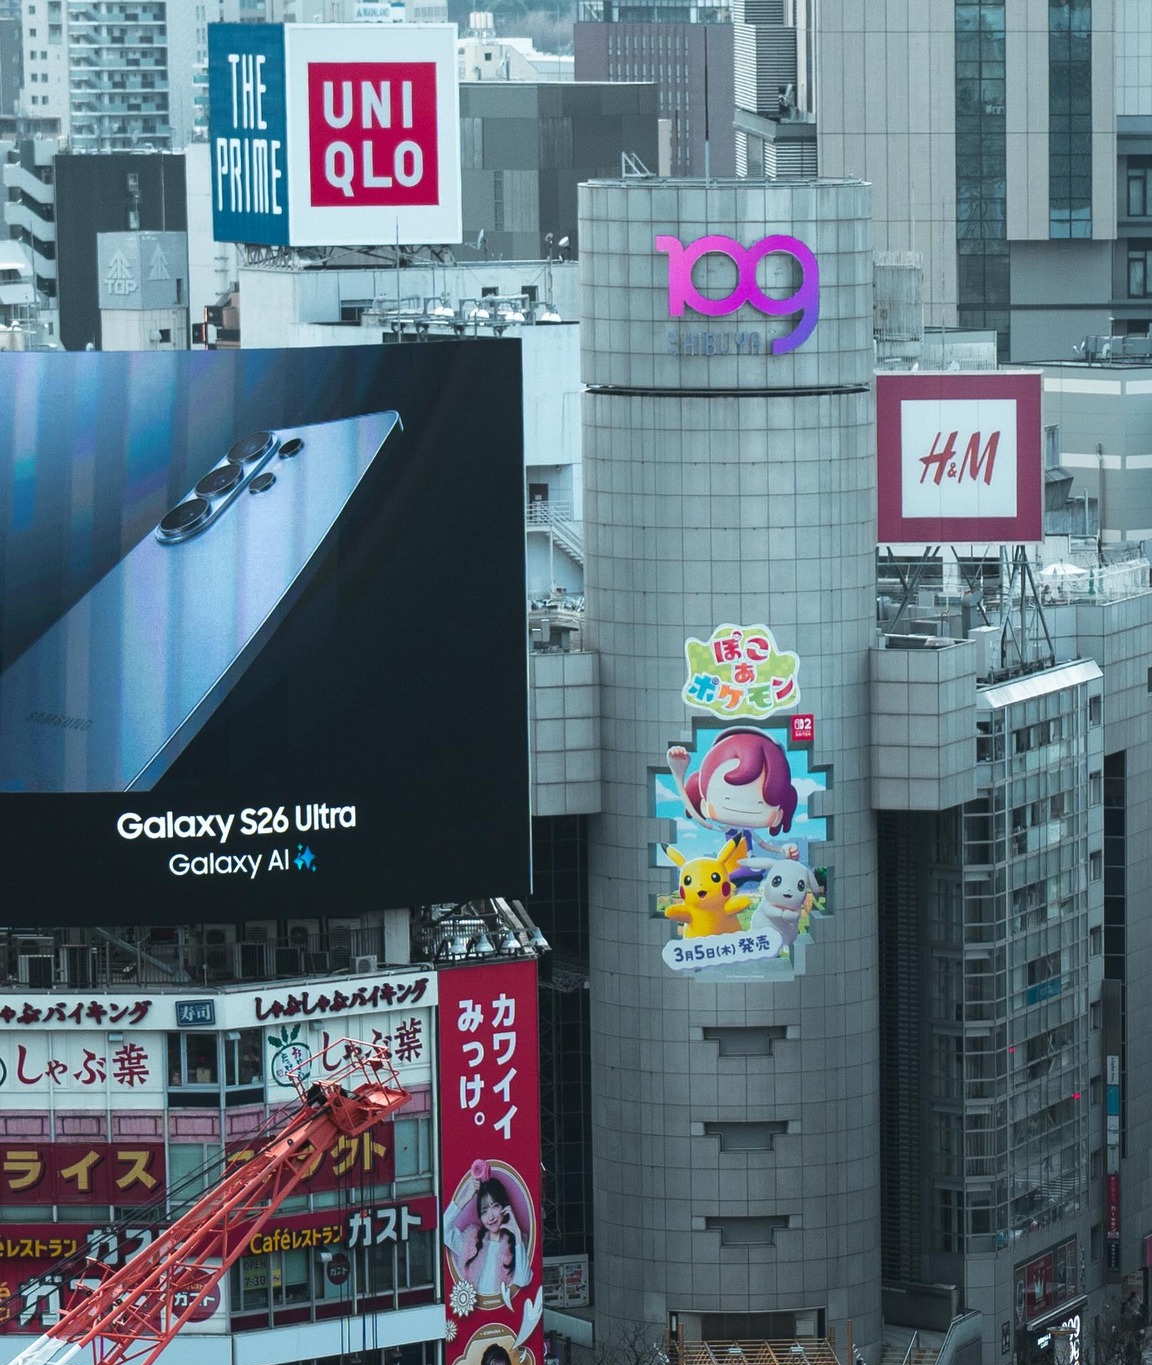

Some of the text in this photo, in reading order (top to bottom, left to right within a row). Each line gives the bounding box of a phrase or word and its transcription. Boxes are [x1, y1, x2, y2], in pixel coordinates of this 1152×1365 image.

[228, 53, 268, 130] THE
[323, 80, 413, 129] UNI
[216, 137, 284, 215] PRIME
[324, 140, 424, 197] QLO
[106, 279, 139, 296] TOP
[655, 234, 820, 355] 109
[667, 331, 761, 356] SHIBUYA
[918, 430, 1001, 486] H&M
[691, 674, 795, 709] ポケモン
[117, 802, 357, 843] Galaxy S26 Ultra
[168, 848, 290, 879] Galaxy AI
[738, 934, 770, 953] 発売
[179, 1004, 212, 1023] 寿司
[17, 1042, 150, 1088] しゃぶ葉
[457, 999, 486, 1127] みっけ。
[491, 993, 517, 1141] カワイイ
[348, 1208, 422, 1249] ガスト
[243, 1260, 266, 1270] OPEN
